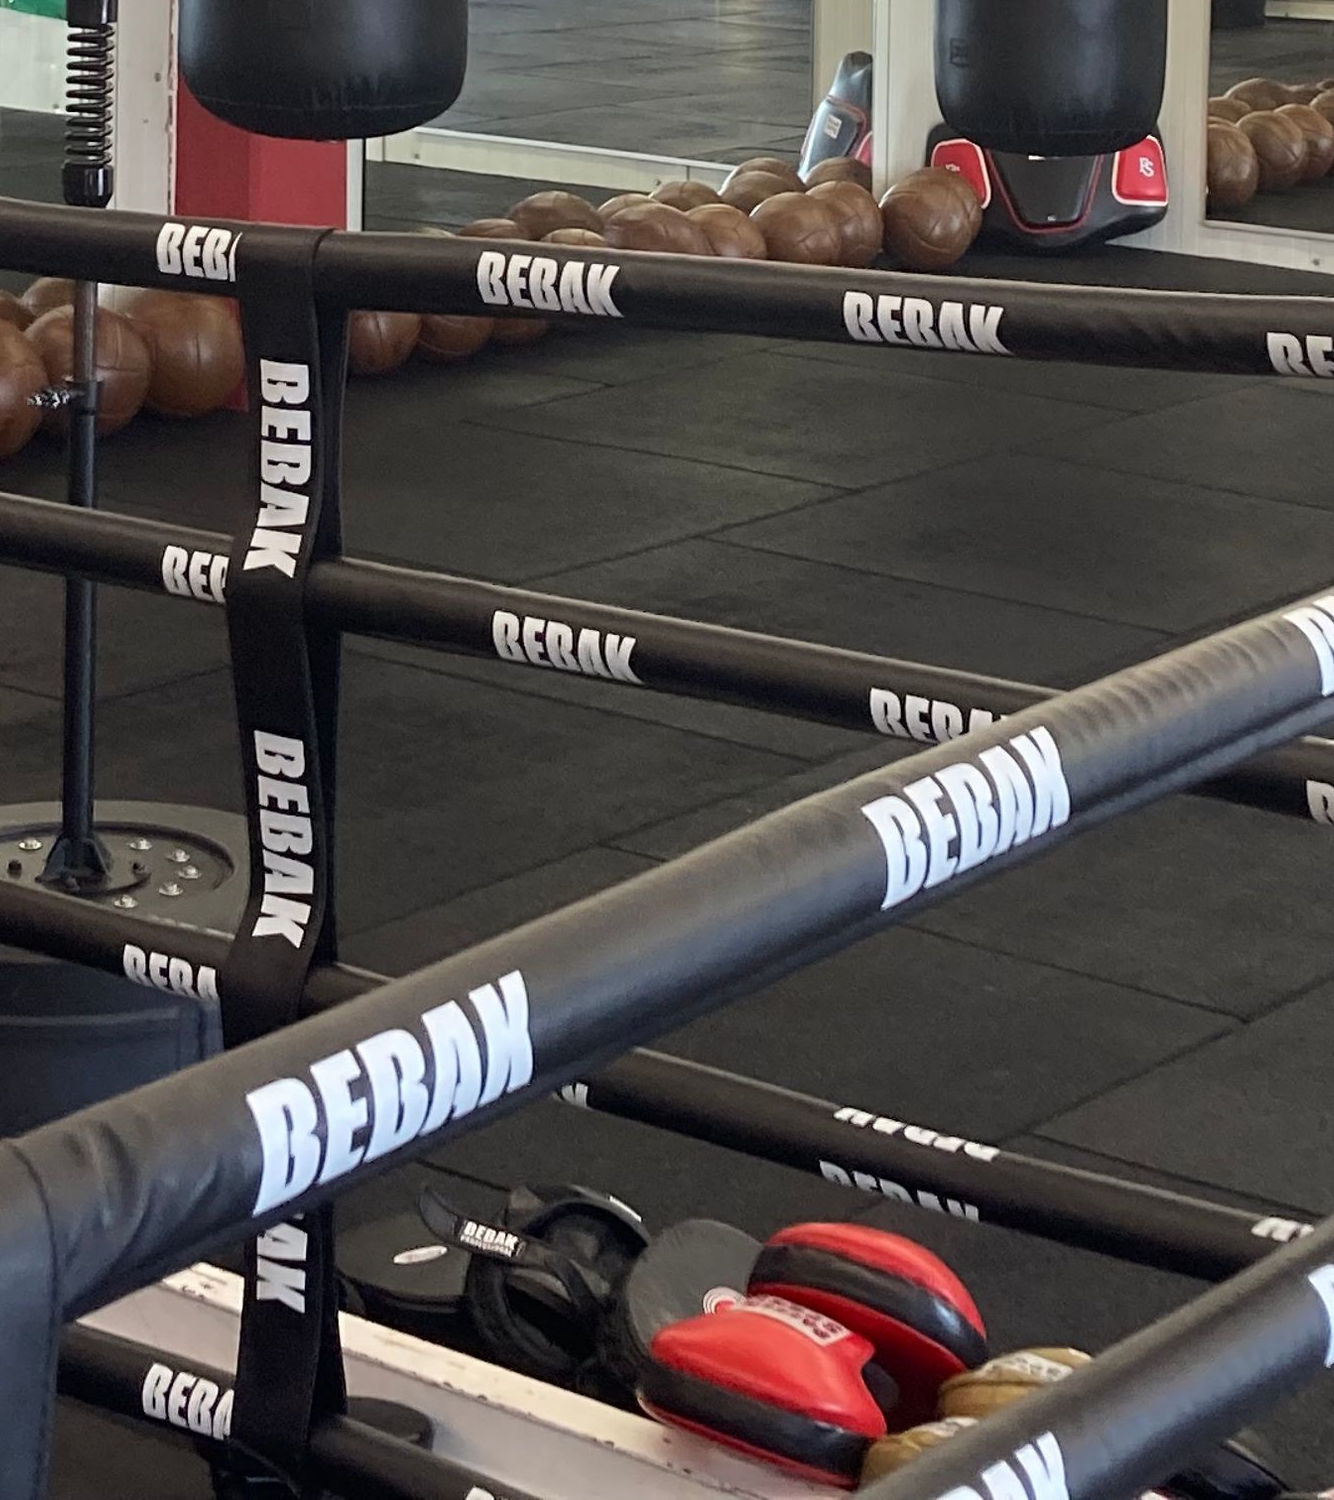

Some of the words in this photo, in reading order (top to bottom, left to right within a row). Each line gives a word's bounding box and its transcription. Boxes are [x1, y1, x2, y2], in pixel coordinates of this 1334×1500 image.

[476, 251, 624, 317] BEBAK
[843, 290, 1014, 355] BEBAK
[243, 359, 311, 578] BEBAK
[491, 610, 645, 684] BEBAK
[252, 730, 315, 948] BEBAK
[862, 726, 1071, 909] BEBAK
[247, 970, 535, 1217] BEBAK
[464, 1221, 518, 1251] BEBAK
